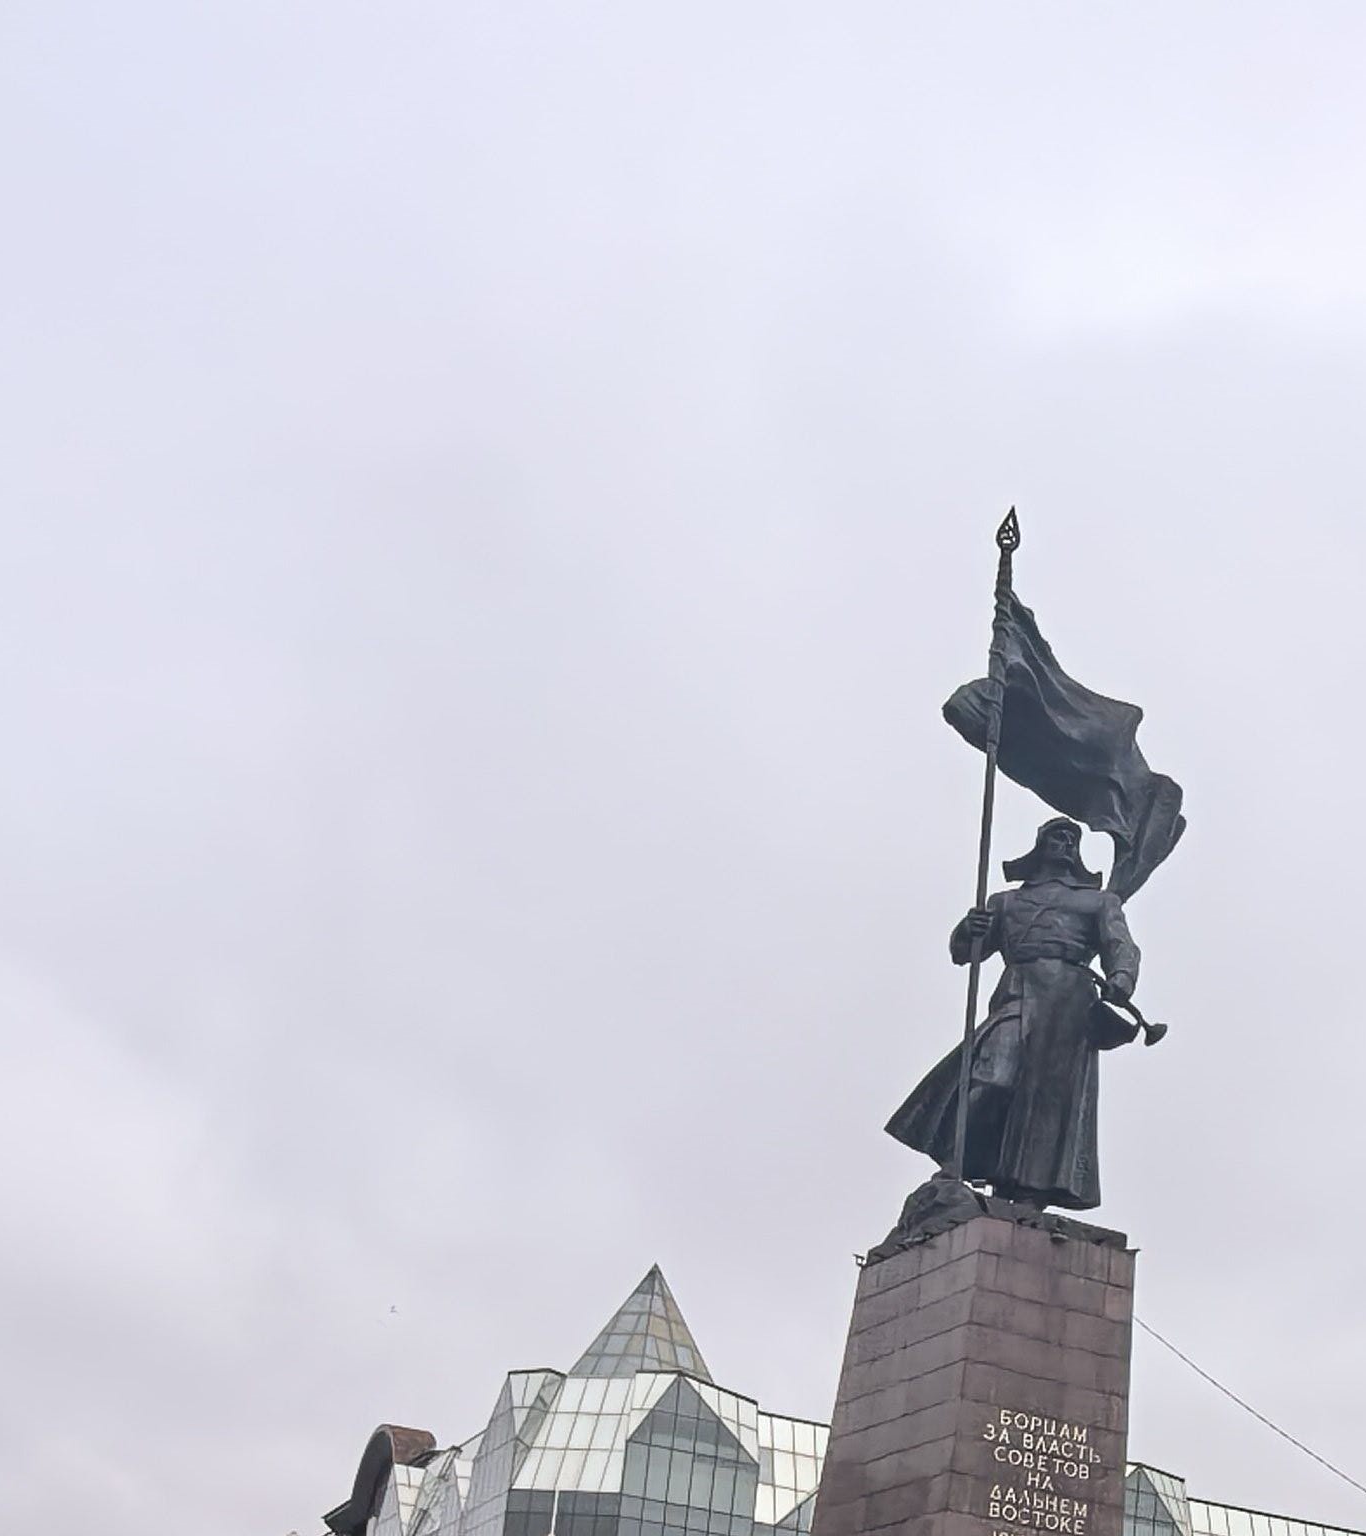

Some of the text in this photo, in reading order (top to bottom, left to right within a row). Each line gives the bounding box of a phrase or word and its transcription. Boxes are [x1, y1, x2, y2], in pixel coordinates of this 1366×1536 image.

[983, 1423, 1101, 1464] ЗА ВЛАСТЬ
[999, 1409, 1088, 1444] БОРЦАМ
[994, 1445, 1090, 1479] СОВЕТОВ
[1026, 1471, 1055, 1492] НА
[989, 1484, 1088, 1518] ДАЛЬНЕМ
[988, 1501, 1086, 1536] ВОСТОКЕ
